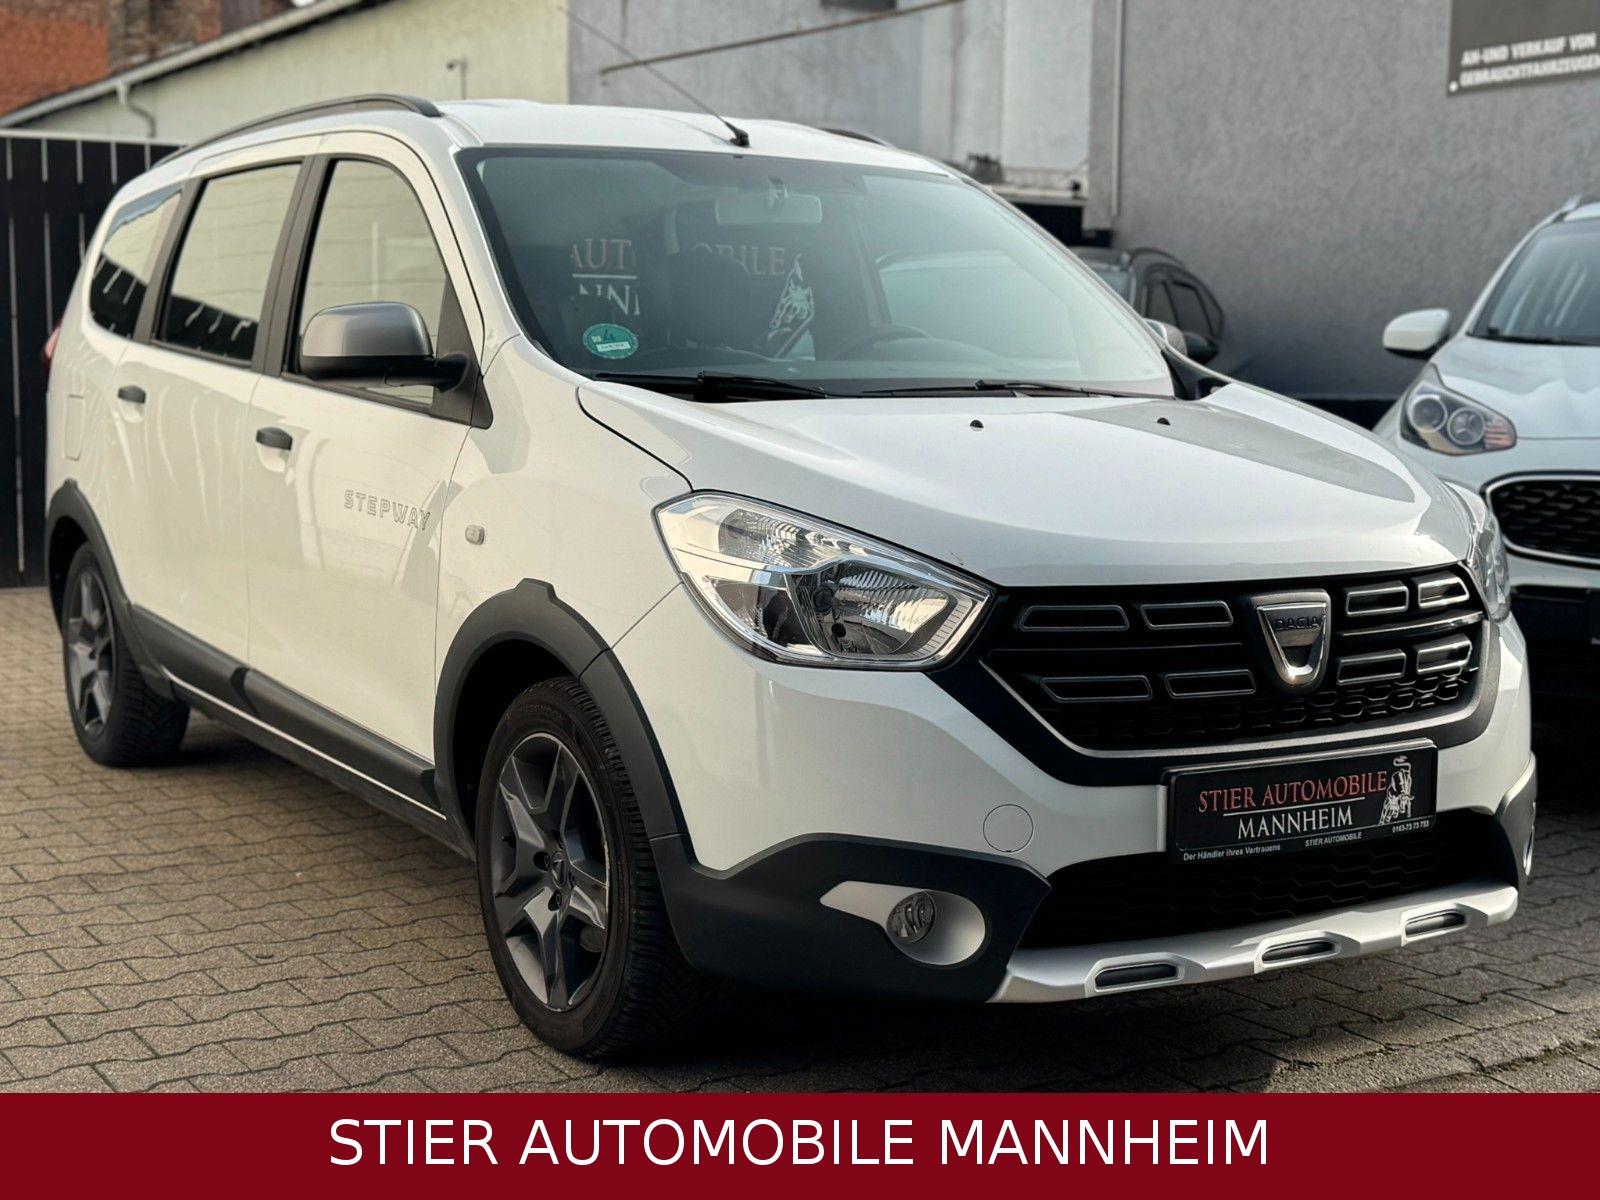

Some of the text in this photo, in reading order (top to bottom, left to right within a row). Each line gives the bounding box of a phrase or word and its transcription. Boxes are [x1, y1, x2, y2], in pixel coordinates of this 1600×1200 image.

[1511, 36, 1566, 60] VERKAUF
[1569, 32, 1597, 51] VON
[344, 489, 431, 531] STEPWAY
[1275, 616, 1320, 631] DACIA
[1198, 771, 1387, 813] STIER AUTOMOBILE
[1237, 804, 1353, 840] MANNHEIM
[1183, 852, 1197, 861] Der
[1197, 850, 1225, 860] Händler
[1245, 844, 1281, 855] Vertrauens
[1305, 831, 1363, 847] STIER AUTOMOBILE
